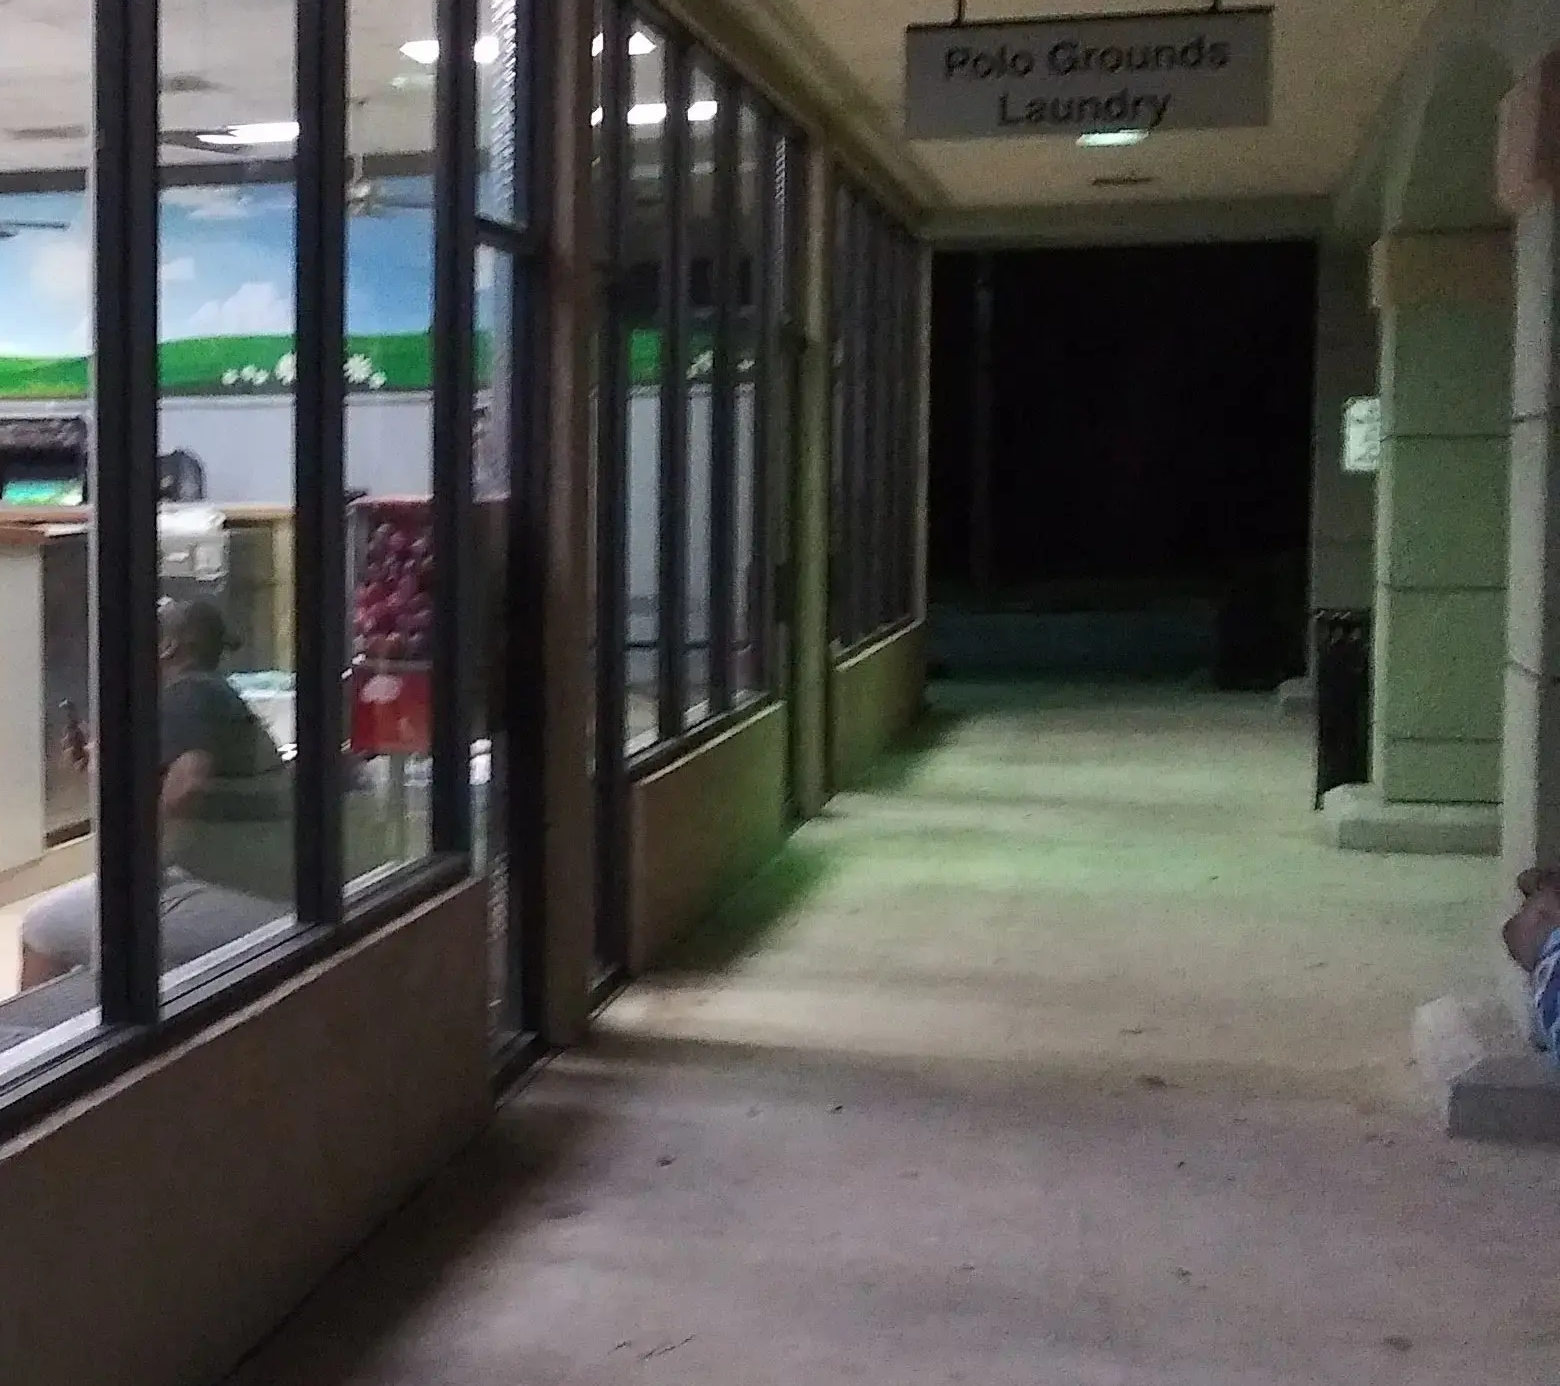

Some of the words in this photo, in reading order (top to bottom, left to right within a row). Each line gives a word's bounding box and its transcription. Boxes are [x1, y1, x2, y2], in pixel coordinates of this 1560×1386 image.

[944, 42, 1035, 81] Polo
[1046, 35, 1230, 76] Grounds
[997, 87, 1172, 130] Laundry
